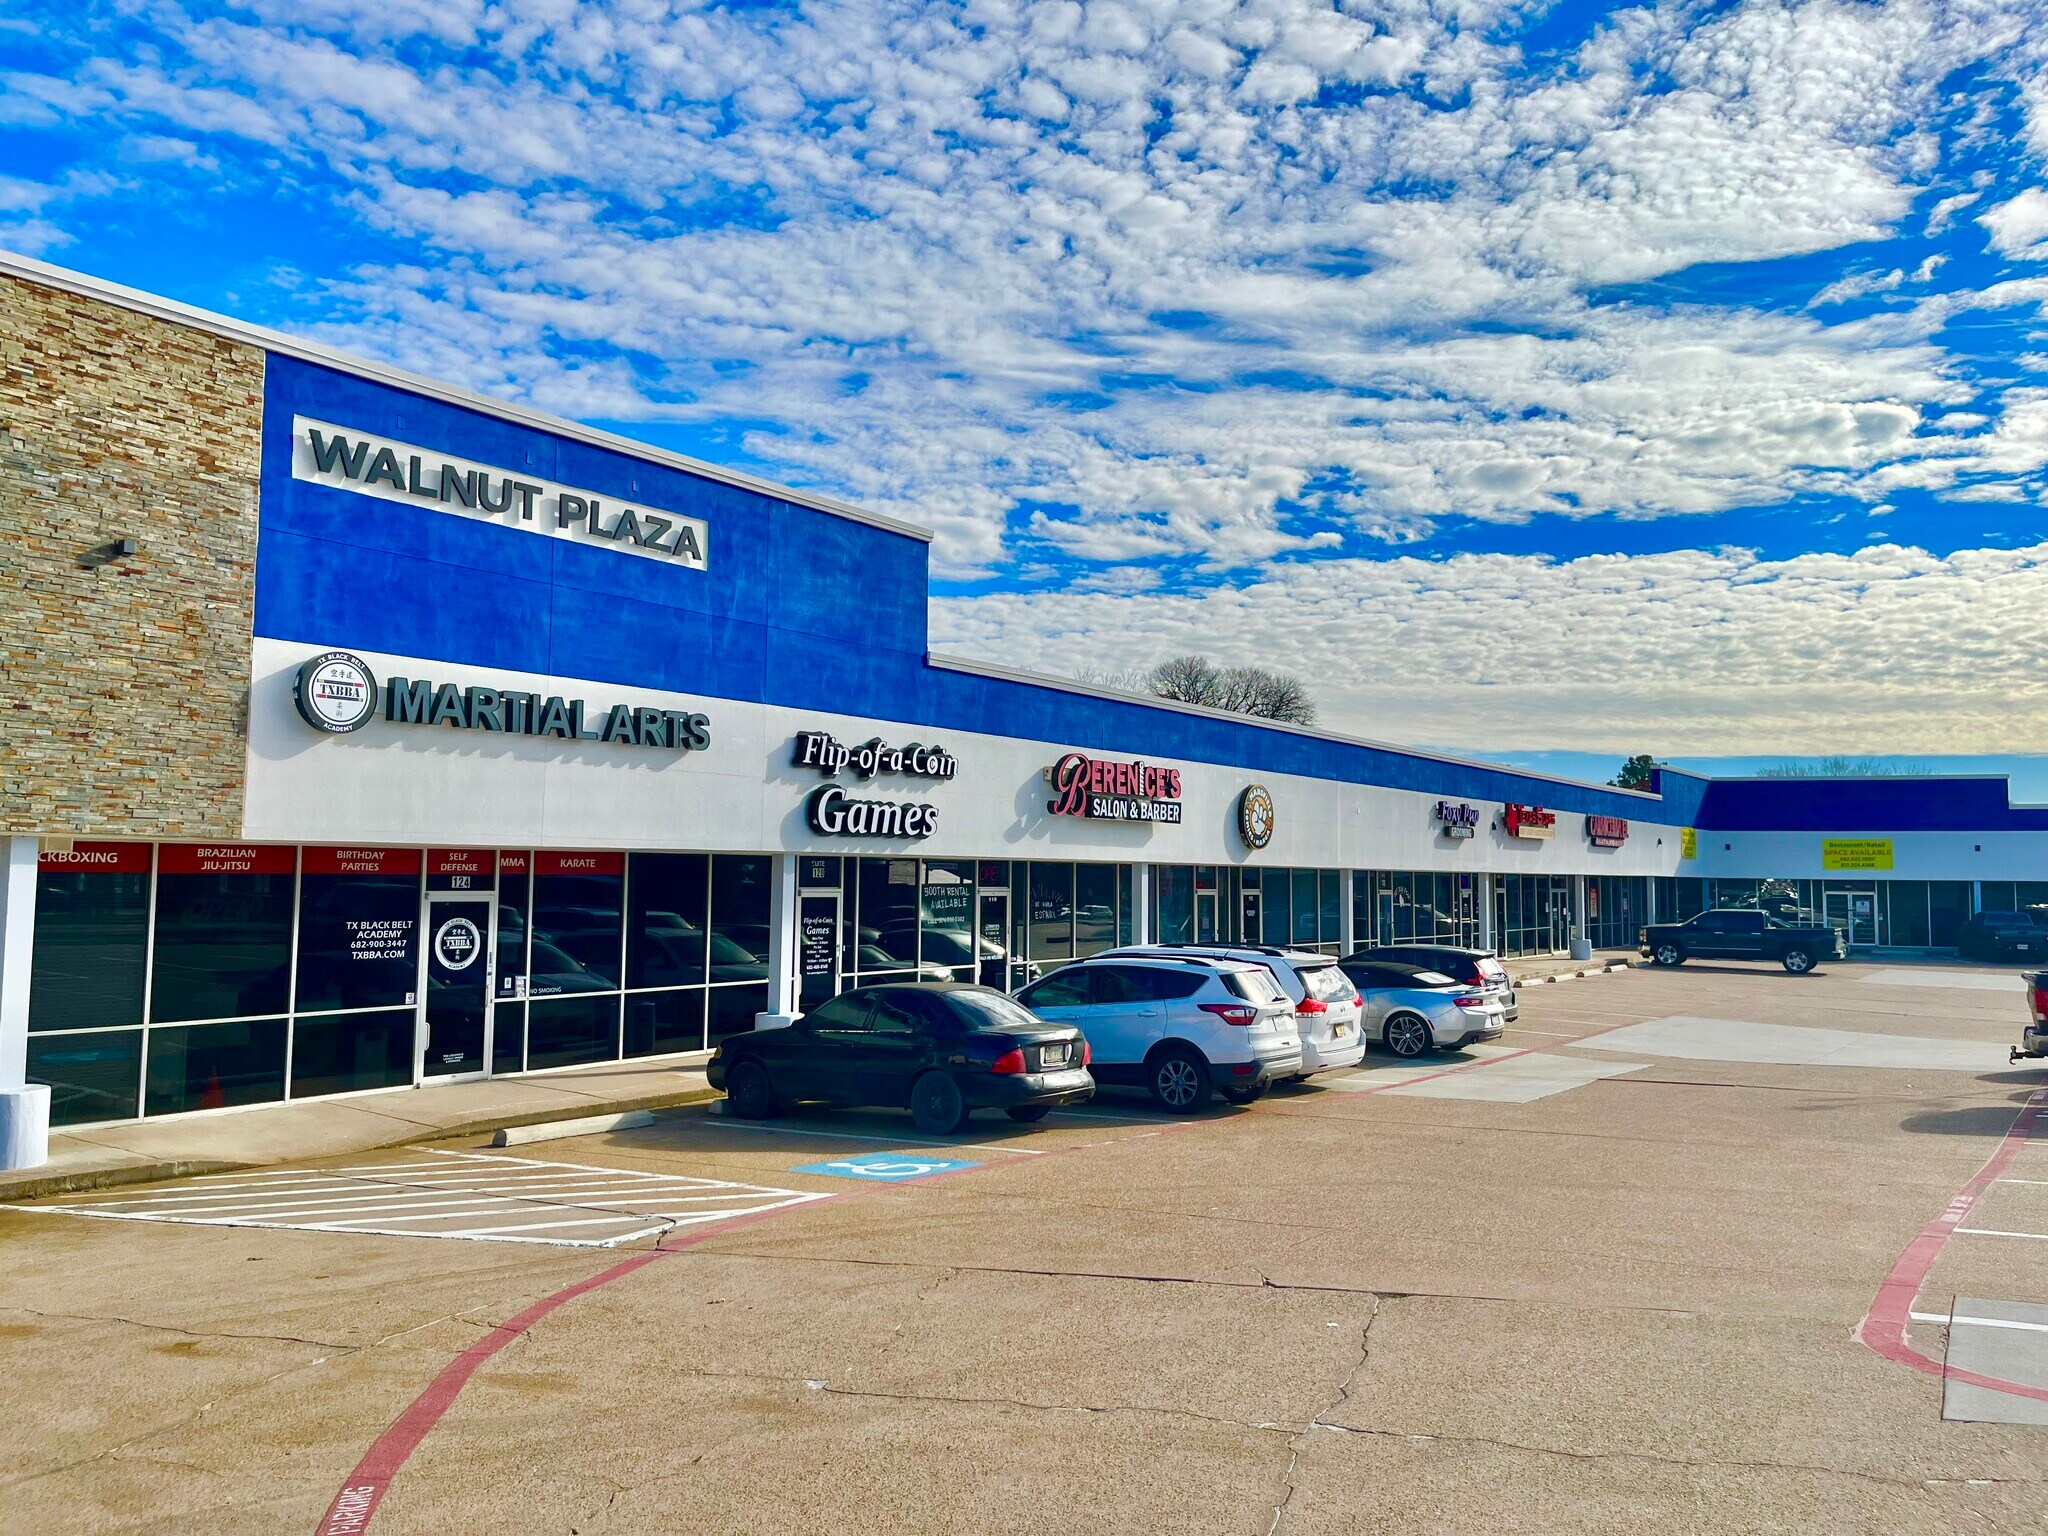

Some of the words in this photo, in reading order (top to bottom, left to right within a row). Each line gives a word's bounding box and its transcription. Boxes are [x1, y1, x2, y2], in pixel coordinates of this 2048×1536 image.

[308, 428, 543, 520] WALNUT
[559, 493, 703, 560] PLAZA
[328, 653, 349, 661] BLACK
[351, 656, 366, 669] BELT
[320, 683, 360, 698] TXBBA
[386, 677, 598, 741] MARTIAL
[602, 704, 711, 751] ARTS
[323, 722, 353, 732] ACADEMY
[802, 733, 959, 778] Flip-of-a-Coin
[818, 788, 939, 836] Games
[1093, 798, 1127, 818] SALON
[1130, 800, 1139, 818] &
[1140, 802, 1180, 822] BARBER
[197, 848, 257, 858] BRAZILIAN
[336, 850, 386, 860] BIRTHDAY
[449, 852, 468, 861] SELF
[201, 861, 251, 870] JIU-JITSU
[341, 862, 379, 871] PARTIES
[500, 857, 525, 867] MMA
[560, 858, 596, 868] KARATE
[440, 863, 478, 872] DEFENSE
[452, 876, 471, 889] 124
[924, 886, 945, 896] BOOTH
[946, 886, 970, 896] RENTAL
[931, 898, 967, 909] AVAILABLE
[346, 921, 358, 930] TX
[360, 920, 390, 929] BLACK
[391, 920, 413, 929] BELT
[356, 930, 402, 939] ACADEMY
[806, 926, 830, 935] Games
[350, 940, 407, 949] 682-900-3447
[352, 950, 405, 960] TXBBA.COM
